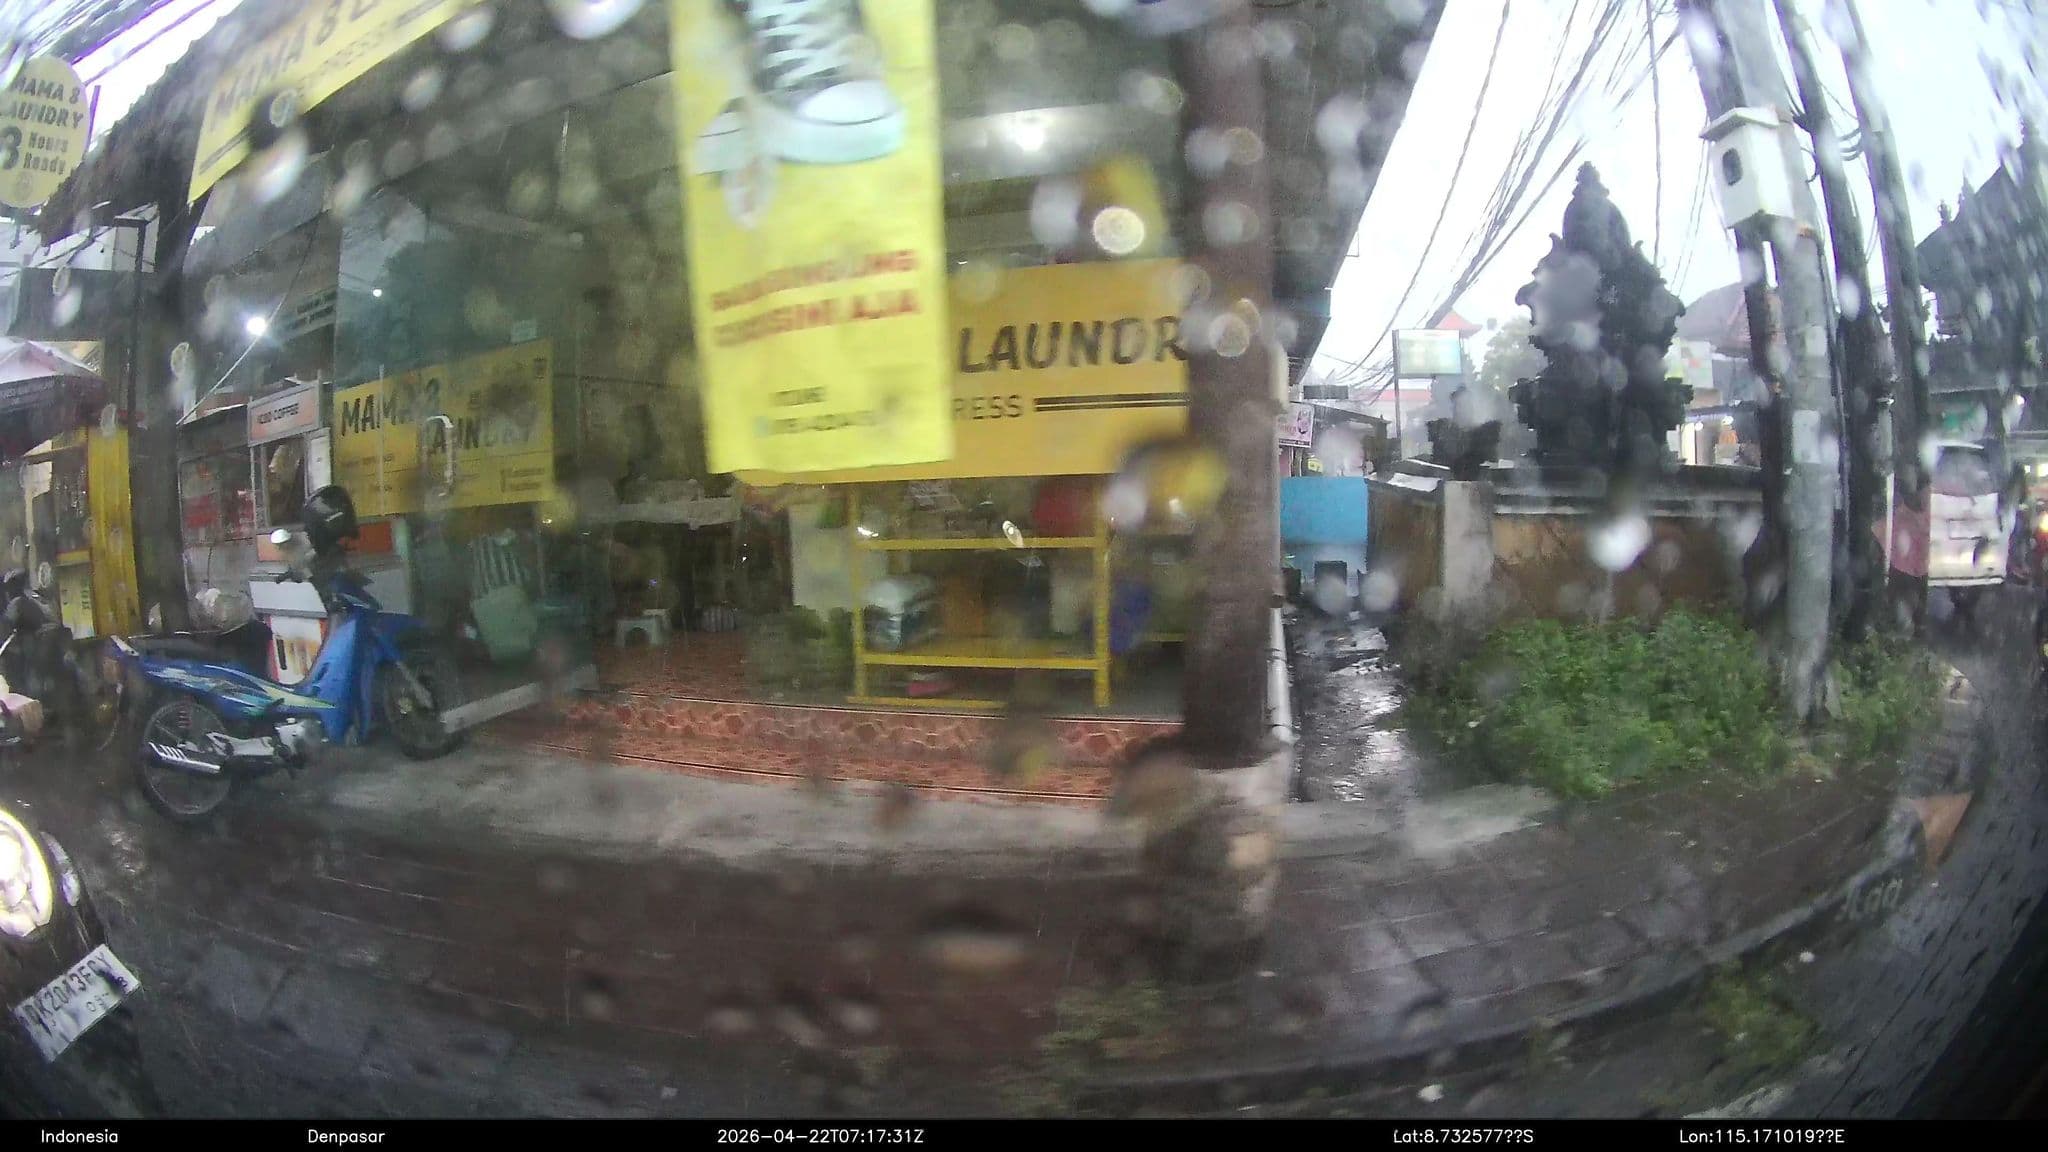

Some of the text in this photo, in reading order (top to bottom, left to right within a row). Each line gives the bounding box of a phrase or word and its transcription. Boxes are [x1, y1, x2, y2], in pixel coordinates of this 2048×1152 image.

[16, 77, 64, 100] MAMA
[0, 101, 83, 128] AUNDRY
[0, 125, 22, 170] 3
[28, 131, 69, 153] Hours
[24, 151, 66, 175] Ready
[957, 316, 1189, 373] LAUNDR
[953, 395, 1023, 419] RESS
